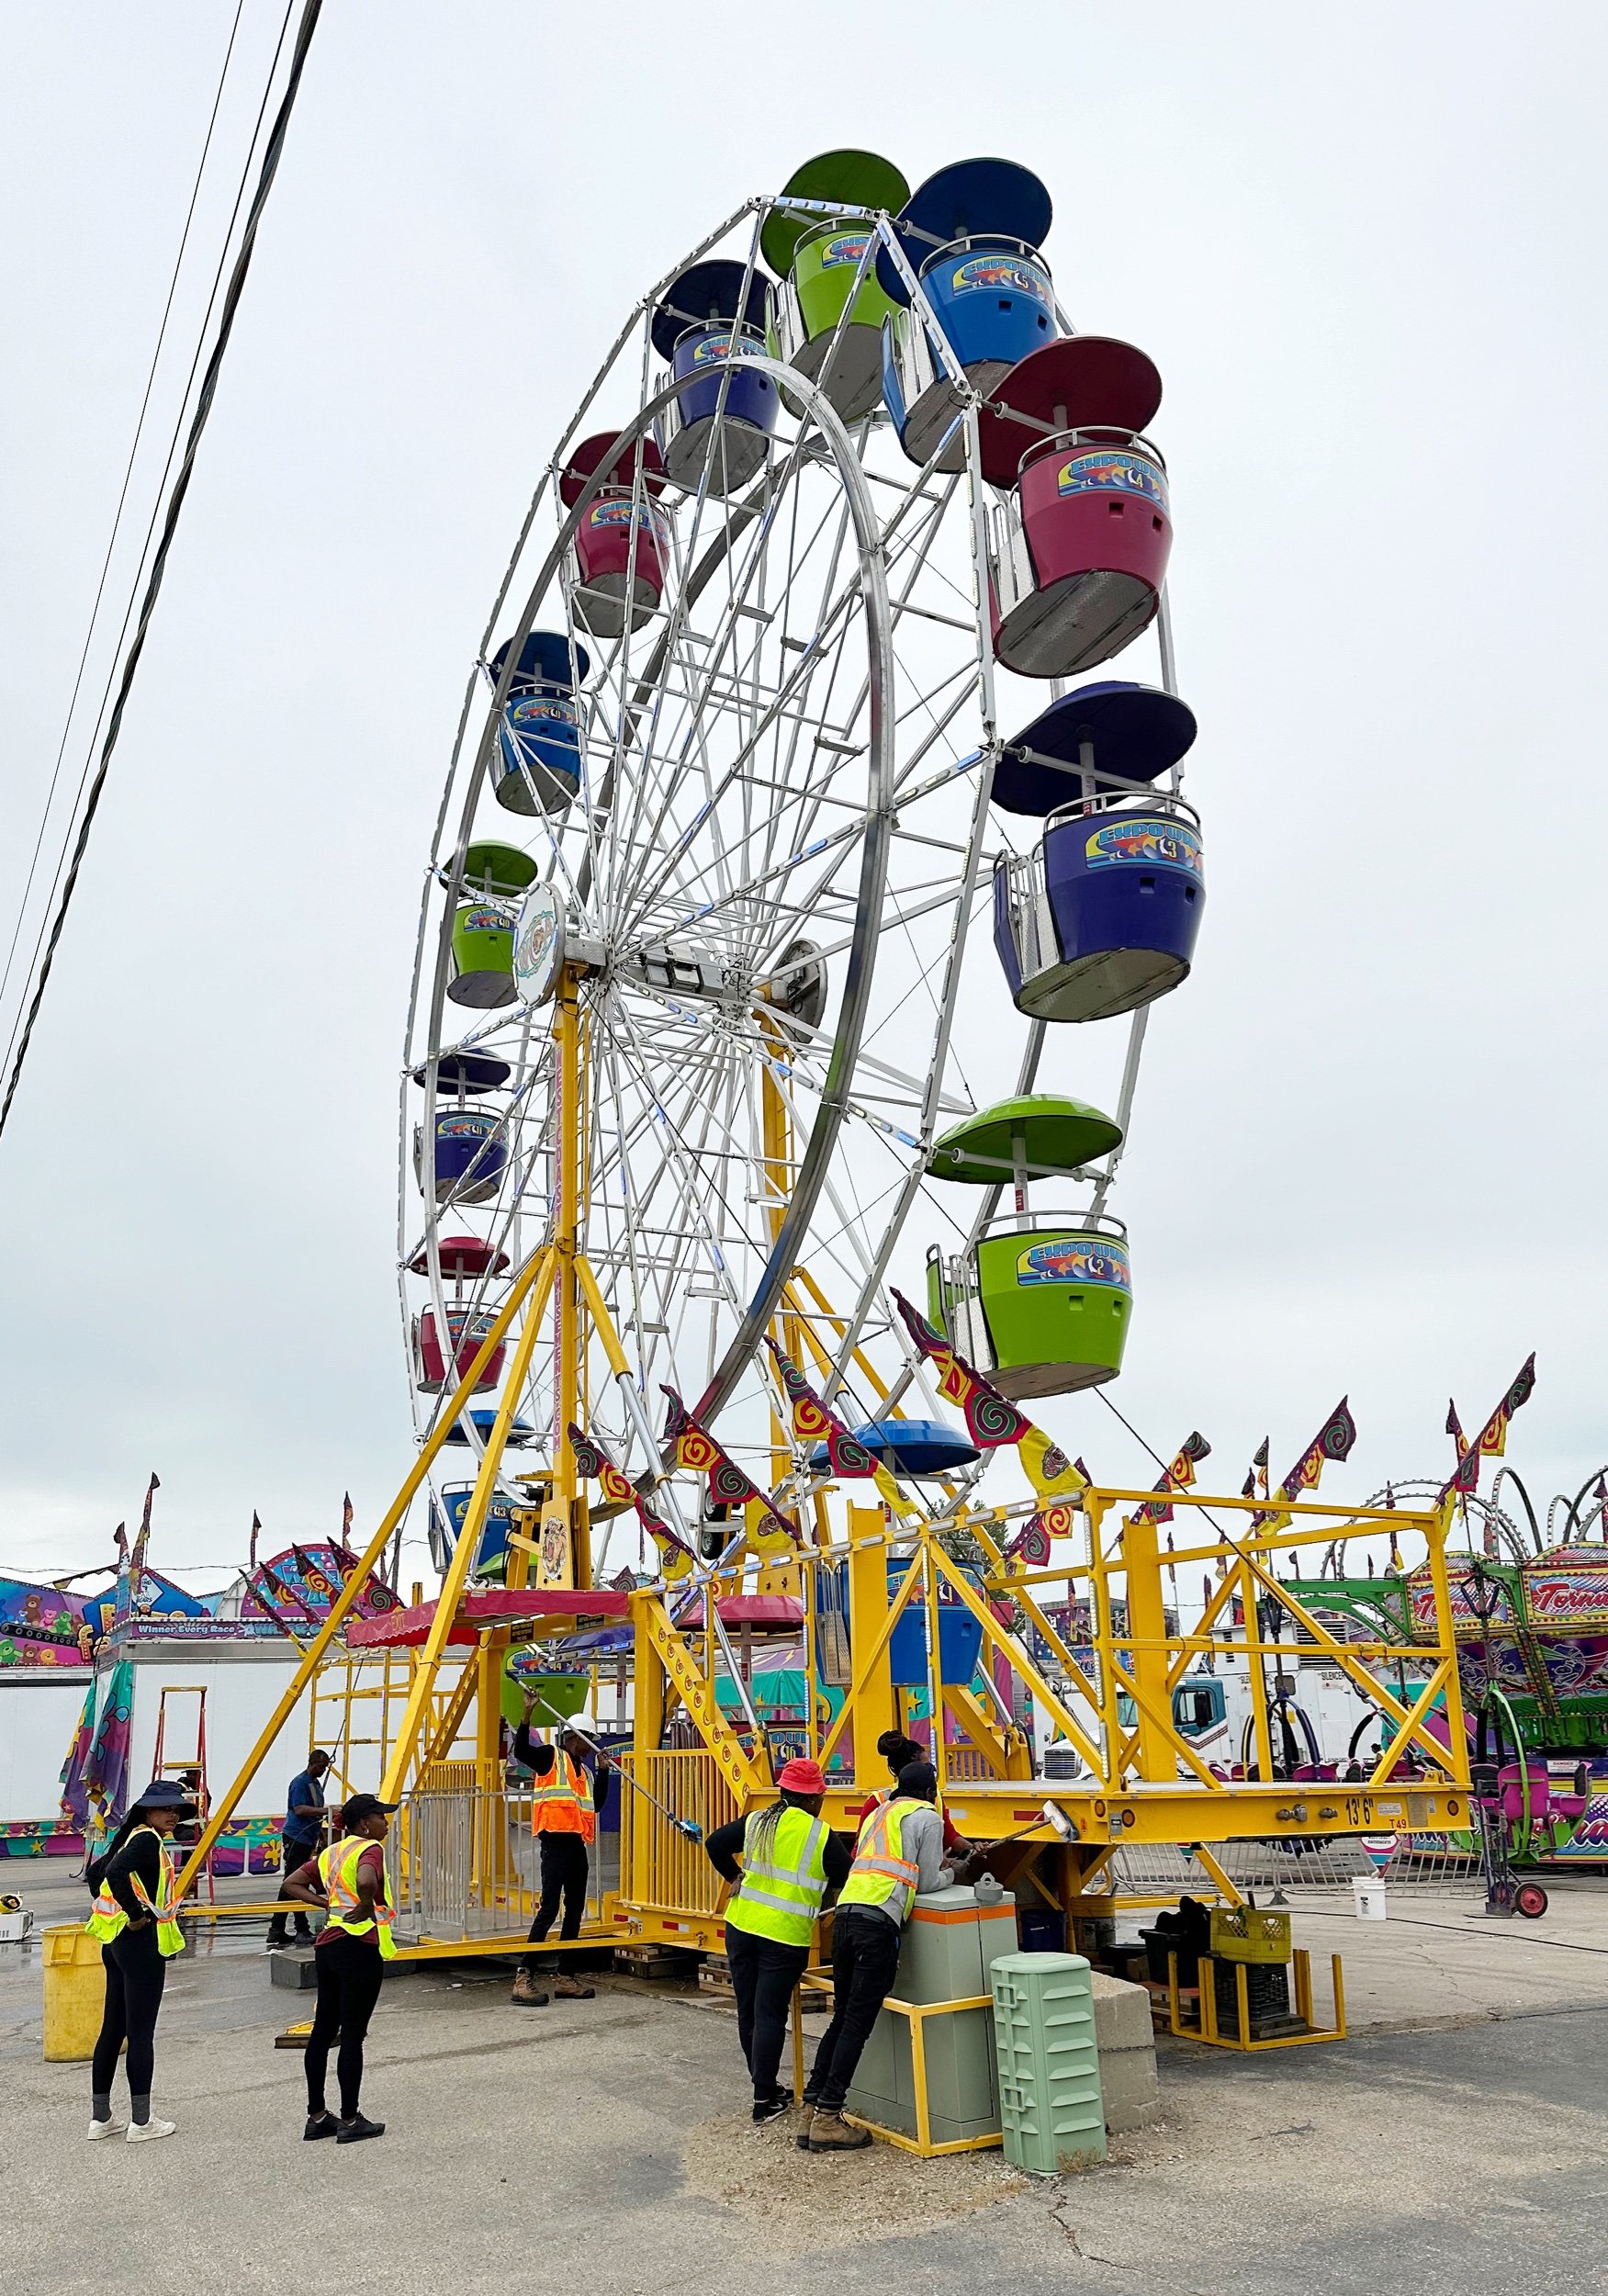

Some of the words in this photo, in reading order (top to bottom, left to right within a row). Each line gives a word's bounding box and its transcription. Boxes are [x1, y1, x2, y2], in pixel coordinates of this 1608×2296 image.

[1137, 473, 1144, 489] 4
[1098, 823, 1164, 846] EXPO
[1167, 840, 1177, 859] 3
[1029, 1242, 1092, 1264] EXPO
[1096, 1258, 1105, 1276] 2
[138, 1625, 175, 1634] Winner
[178, 1625, 208, 1635] Every
[210, 1625, 235, 1634] Race
